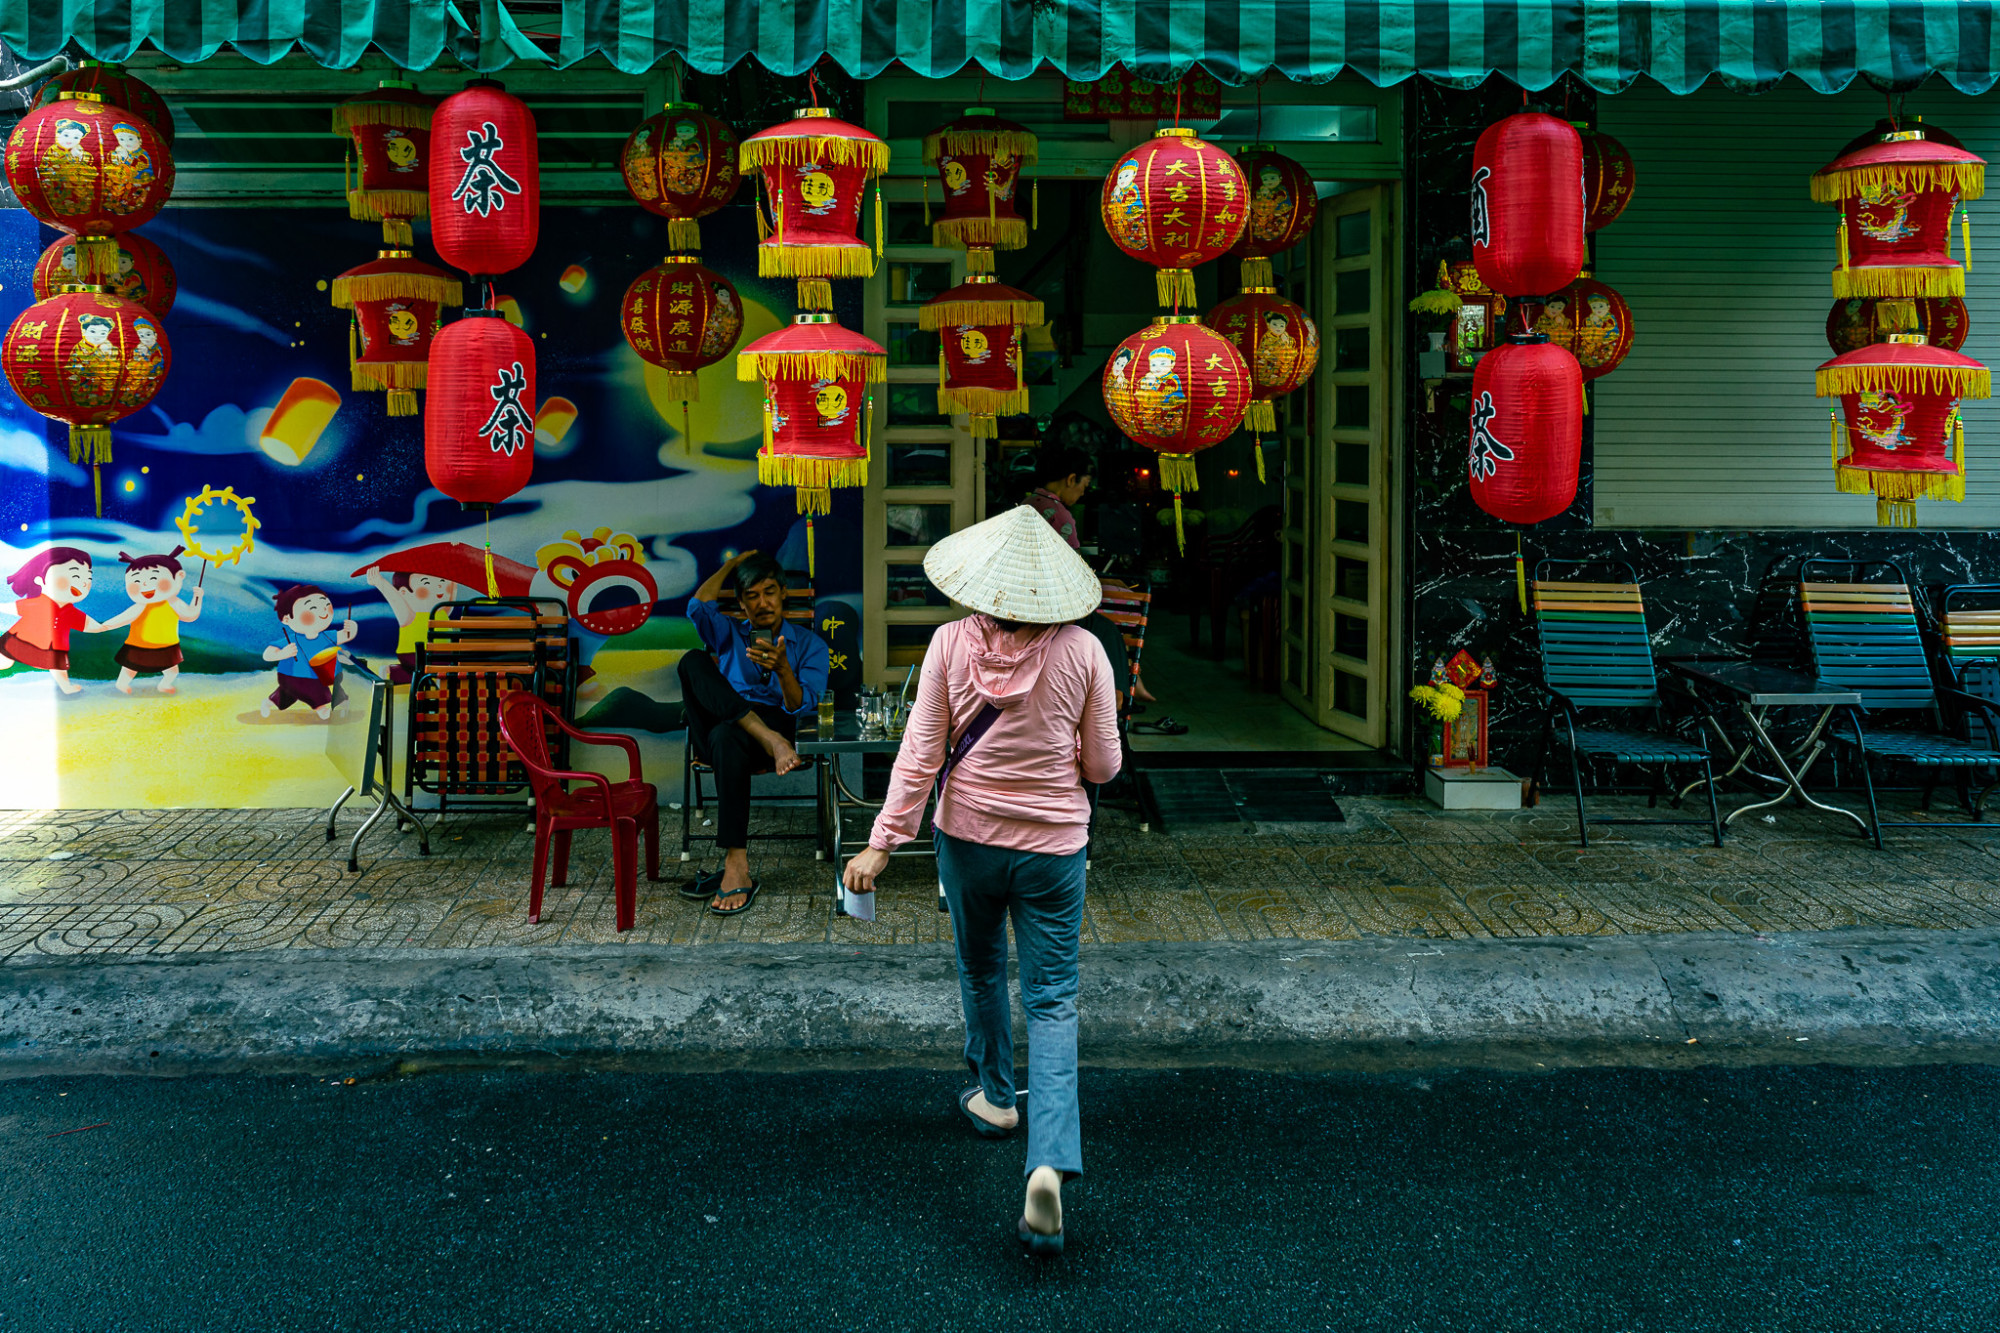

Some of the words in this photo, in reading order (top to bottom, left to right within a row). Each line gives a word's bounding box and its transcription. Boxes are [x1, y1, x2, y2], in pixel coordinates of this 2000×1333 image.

[452, 121, 521, 217] 茶
[1161, 159, 1196, 248] 大吉大利
[1206, 158, 1238, 248] 萬事如意
[629, 279, 655, 352] 恭喜發財
[668, 281, 696, 353] 財源廣進
[16, 320, 61, 407] 財源廣進
[1198, 353, 1232, 439] 大吉大利
[478, 361, 533, 456] 茶
[1469, 391, 1514, 483] 茶
